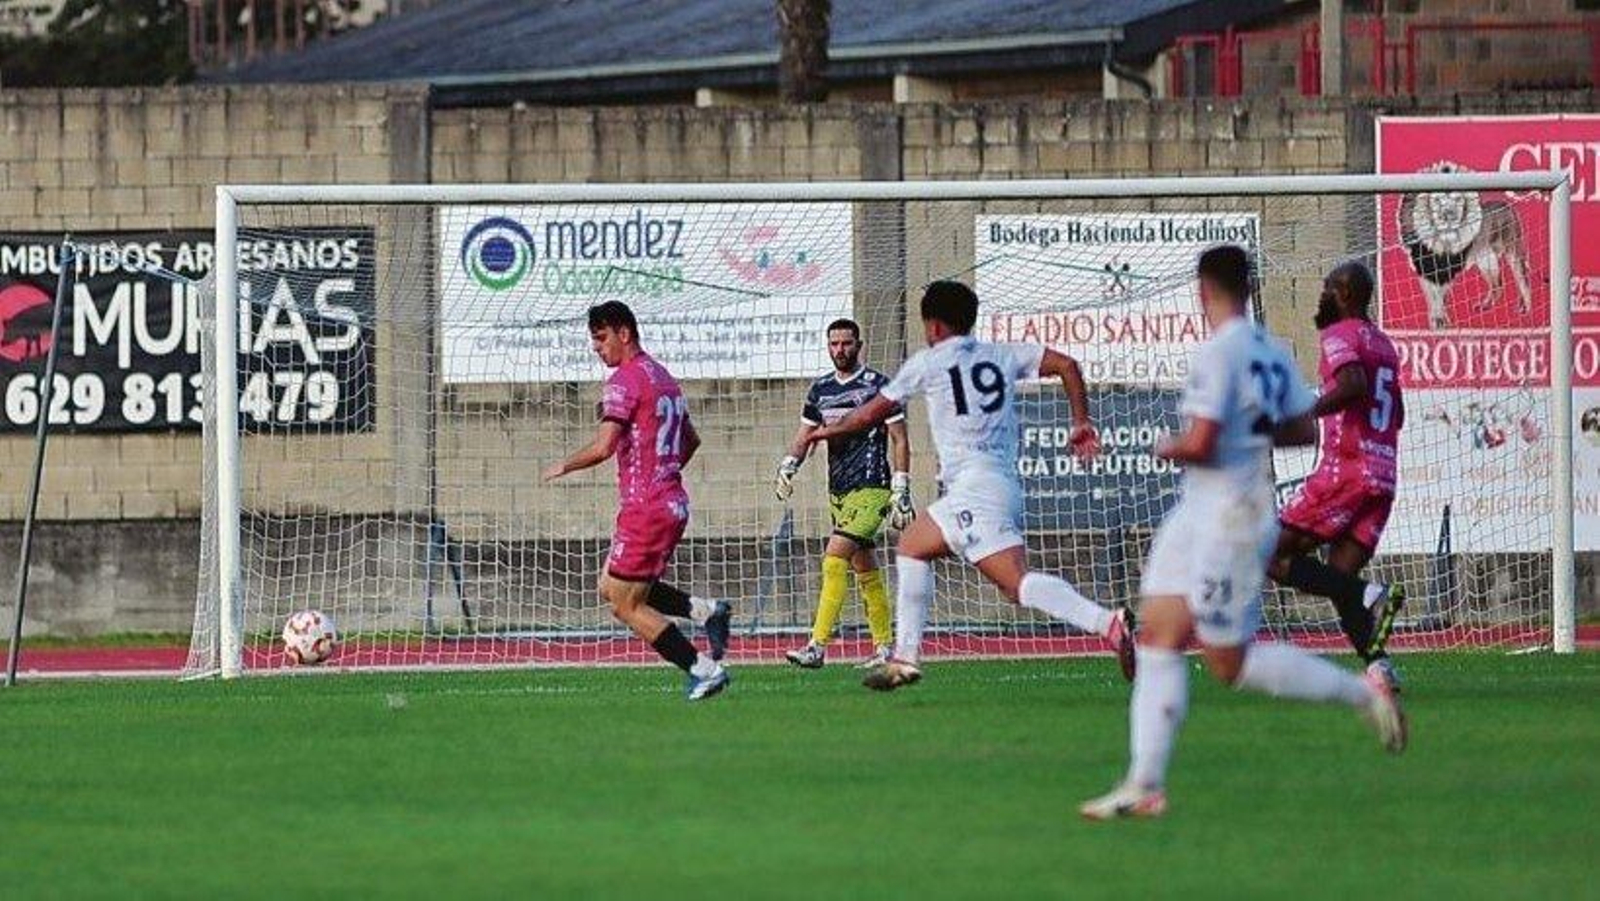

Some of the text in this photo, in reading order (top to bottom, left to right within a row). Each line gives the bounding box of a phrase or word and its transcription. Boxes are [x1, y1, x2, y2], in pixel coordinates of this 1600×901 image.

[1499, 142, 1600, 201] CE
[545, 209, 684, 259] mendez
[989, 221, 1060, 247] Bodega
[1067, 219, 1155, 243] Hacienda
[0, 239, 358, 275] MBUTIDOS ARESANOS
[1090, 360, 1188, 379] DEGAS
[1399, 340, 1549, 381] PROTEGE
[5, 372, 105, 425] 629
[240, 371, 340, 422] 479
[947, 361, 1006, 415] 19
[1369, 366, 1394, 432] 5
[1024, 420, 1171, 448] FEDACIÓN
[956, 509, 973, 530] 19
